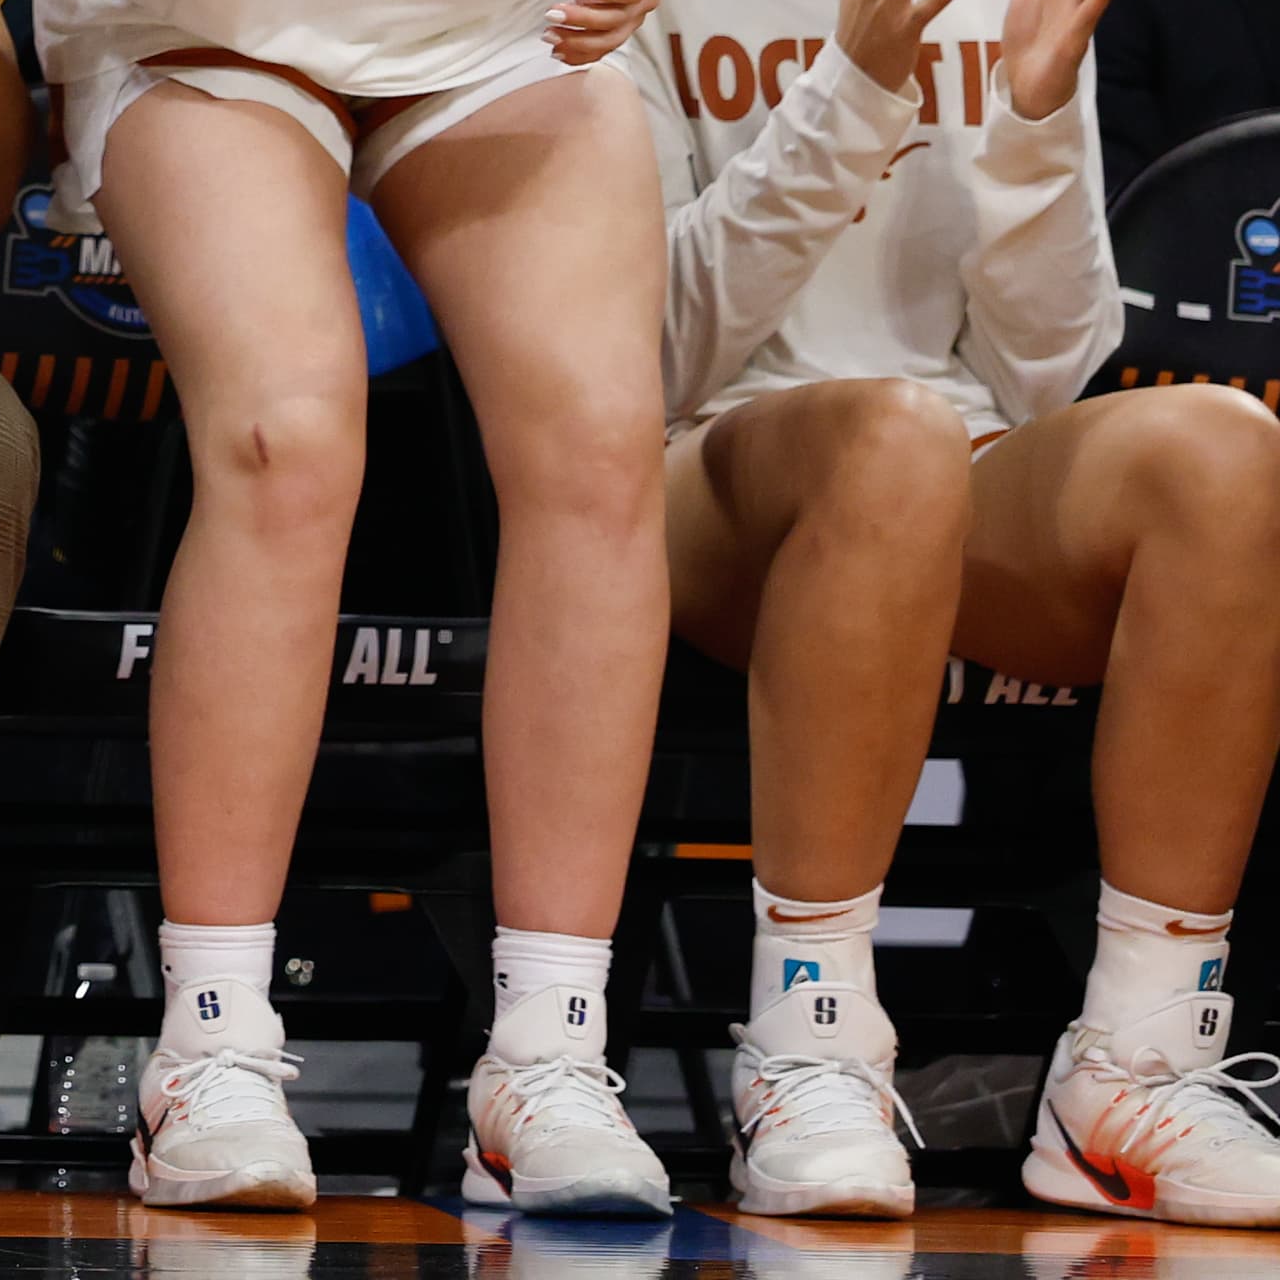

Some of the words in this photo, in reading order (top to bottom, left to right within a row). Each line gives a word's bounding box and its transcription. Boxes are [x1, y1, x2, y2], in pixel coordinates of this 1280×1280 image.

[669, 33, 828, 122] LOC
[917, 42, 944, 126] T
[958, 40, 1005, 127] I
